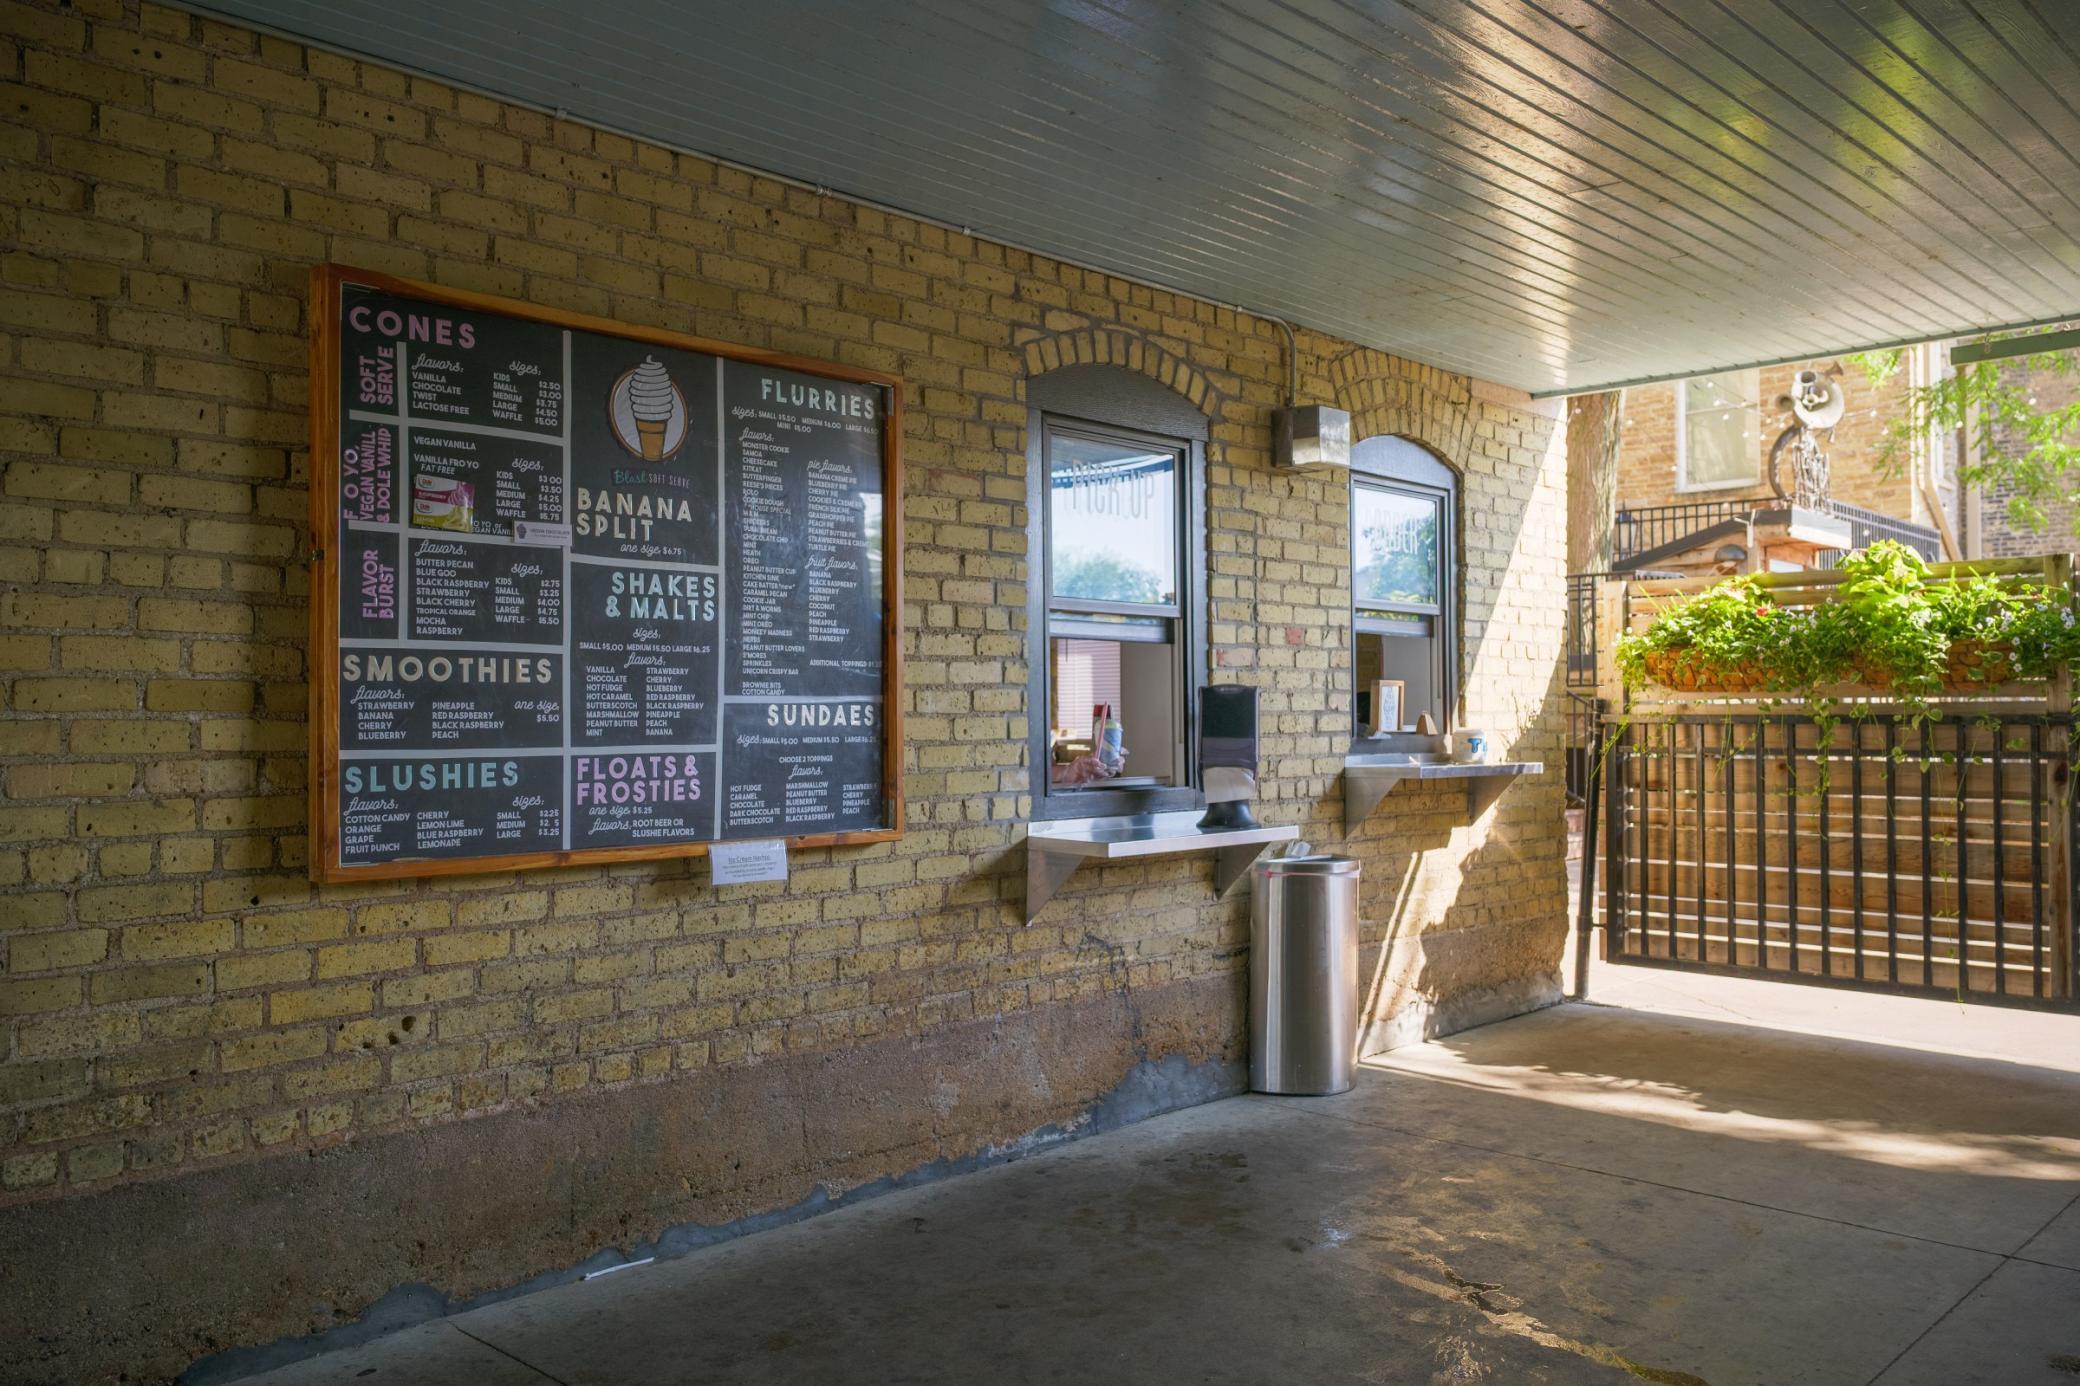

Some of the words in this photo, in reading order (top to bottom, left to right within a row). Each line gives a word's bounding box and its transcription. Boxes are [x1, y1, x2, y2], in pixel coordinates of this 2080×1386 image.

[349, 305, 476, 349] CONES
[359, 355, 377, 404] SOFT
[377, 346, 394, 406] SERVE
[412, 372, 447, 384] VANILLA
[493, 372, 511, 382] KIDS
[538, 380, 561, 391] $2.50
[412, 382, 462, 395] CHOCOLATE
[493, 381, 518, 393] SMALL
[538, 390, 562, 400] $3.00
[412, 391, 437, 401] TWIST
[493, 390, 523, 403] MEDIUM
[761, 378, 875, 421] FLURRIES
[412, 401, 449, 412] LACTOSE
[449, 405, 470, 415] FREE
[493, 400, 518, 411] LARGE
[536, 408, 558, 418] $4.50
[492, 409, 524, 422] WAFFLE
[758, 411, 777, 421] SMALL
[801, 417, 823, 427] MEDIUM
[777, 421, 792, 430] MINI
[377, 427, 392, 467] WHIP
[413, 435, 444, 447] VEGAN
[443, 439, 477, 451] VANILLA
[742, 441, 769, 452] MONSTER
[769, 444, 791, 454] COOKIE
[420, 463, 436, 472] FAT
[742, 457, 778, 468] CHEESECAKE
[496, 471, 514, 480] KIDS
[648, 472, 666, 485] SOFT
[669, 474, 691, 489] SERVE
[742, 472, 782, 483] BUTTERFINGER
[377, 470, 391, 510] DOLE
[496, 480, 521, 490] SMALL
[540, 484, 562, 494] $3.50
[1073, 458, 1120, 516] PICK
[1131, 470, 1154, 520] UP
[360, 477, 375, 520] VEGAN
[496, 489, 526, 500] MEDIUM
[538, 493, 560, 503] $4.25
[496, 498, 521, 508] LARGE
[577, 487, 693, 523] BANANA
[496, 508, 527, 519] WAFFLE
[576, 512, 654, 542] SPLIT
[620, 543, 638, 553] one
[416, 558, 446, 567] BUTTER
[446, 559, 474, 569] PECAN
[416, 568, 437, 577] BLUE
[437, 569, 457, 578] GOO
[742, 564, 765, 573] PEANUT
[765, 566, 785, 574] BUTTER
[742, 573, 767, 581] KITCHEN
[809, 570, 832, 579] BANANA
[362, 549, 379, 619] FLAVOR
[416, 577, 443, 587] BLACK
[444, 579, 490, 589] RASPBERRY
[540, 579, 561, 588] $2.75
[611, 571, 715, 599] SHAKES
[379, 563, 394, 619] BURST
[416, 587, 470, 597] STRAWBERRY
[539, 589, 560, 598] $3.25
[742, 589, 768, 597] CARAMEL
[769, 590, 788, 598] PECAN
[809, 587, 840, 596] BLUEBERRY
[416, 597, 443, 606] BLACK
[443, 598, 476, 608] CHERRY
[537, 598, 561, 607] $4.00
[809, 602, 836, 611] COCONUT
[416, 608, 448, 616] TROPICAL
[448, 608, 477, 617] ORANGE
[537, 607, 558, 616] $4.75
[605, 595, 621, 618] &
[630, 596, 715, 622] MALTS
[416, 616, 447, 625] MOCHA
[809, 618, 838, 627] PINEAPPLE
[416, 626, 463, 636] RASPBERRY
[809, 634, 844, 643] STRAWBERRY
[579, 641, 602, 650] SMALL
[626, 643, 652, 652] MEDIUM
[671, 645, 692, 653] LARGE
[342, 653, 552, 684] SMOOTHIES
[809, 659, 841, 668] ADDITIONAL
[586, 665, 616, 674] VANILLA
[646, 667, 689, 675] STRAWBERRY
[586, 675, 628, 683] CHOCOLATE
[586, 684, 601, 692] HOT
[601, 684, 624, 692] FUDGE
[646, 684, 683, 693] BLUEBERRY
[766, 688, 785, 696] CANDY
[357, 700, 415, 711] STRAWBERRY
[432, 701, 476, 711] PINEAPPLE
[586, 702, 638, 710] BUTTERSCOTCH
[357, 711, 395, 720] BANANA
[432, 711, 448, 720] RED
[586, 710, 640, 719] MARSHMALLOW
[646, 711, 681, 719] PINEAPPLE
[767, 703, 875, 728] SUNDAES
[357, 721, 393, 730] CHERRY
[586, 719, 613, 728] PEANUT
[613, 719, 638, 728] BUTTER
[646, 719, 668, 728] PEACH
[357, 730, 407, 740] BLUEBERRY
[432, 729, 460, 739] PEACH
[779, 756, 802, 765] CHOOSE
[807, 754, 834, 763] TOPPINGS
[577, 755, 677, 781] FLOATS
[684, 754, 699, 778] &
[344, 760, 519, 794] SLUSHIES
[786, 781, 829, 790] MARSHMALLOW
[577, 778, 701, 806] FROSTIES
[730, 792, 758, 801] CARAMEL
[842, 792, 864, 800] CHERRY
[730, 800, 766, 809] CHOCOLATE
[786, 797, 818, 806] BLUEBERRY
[730, 808, 747, 818] DARK
[746, 807, 781, 817] CHOCOLATE
[842, 807, 860, 815] PEACH
[344, 813, 381, 824] COTTON
[381, 812, 411, 822] CANDY
[730, 816, 775, 826] BUTTERSCOTCH
[786, 814, 805, 823] BLACK
[805, 812, 836, 822] RASPBERRY
[632, 818, 653, 828] ROOT
[654, 818, 672, 828] BEER
[672, 818, 684, 827] OR
[344, 824, 383, 834] ORANGE
[632, 828, 662, 838] SLUSHIE
[662, 827, 695, 837] FLAVORS
[344, 834, 376, 844] GRAPE
[416, 830, 438, 841] BLUE
[345, 844, 370, 855] FRUIT
[370, 842, 401, 852] PUNCH
[417, 838, 462, 850] LEMONADE
